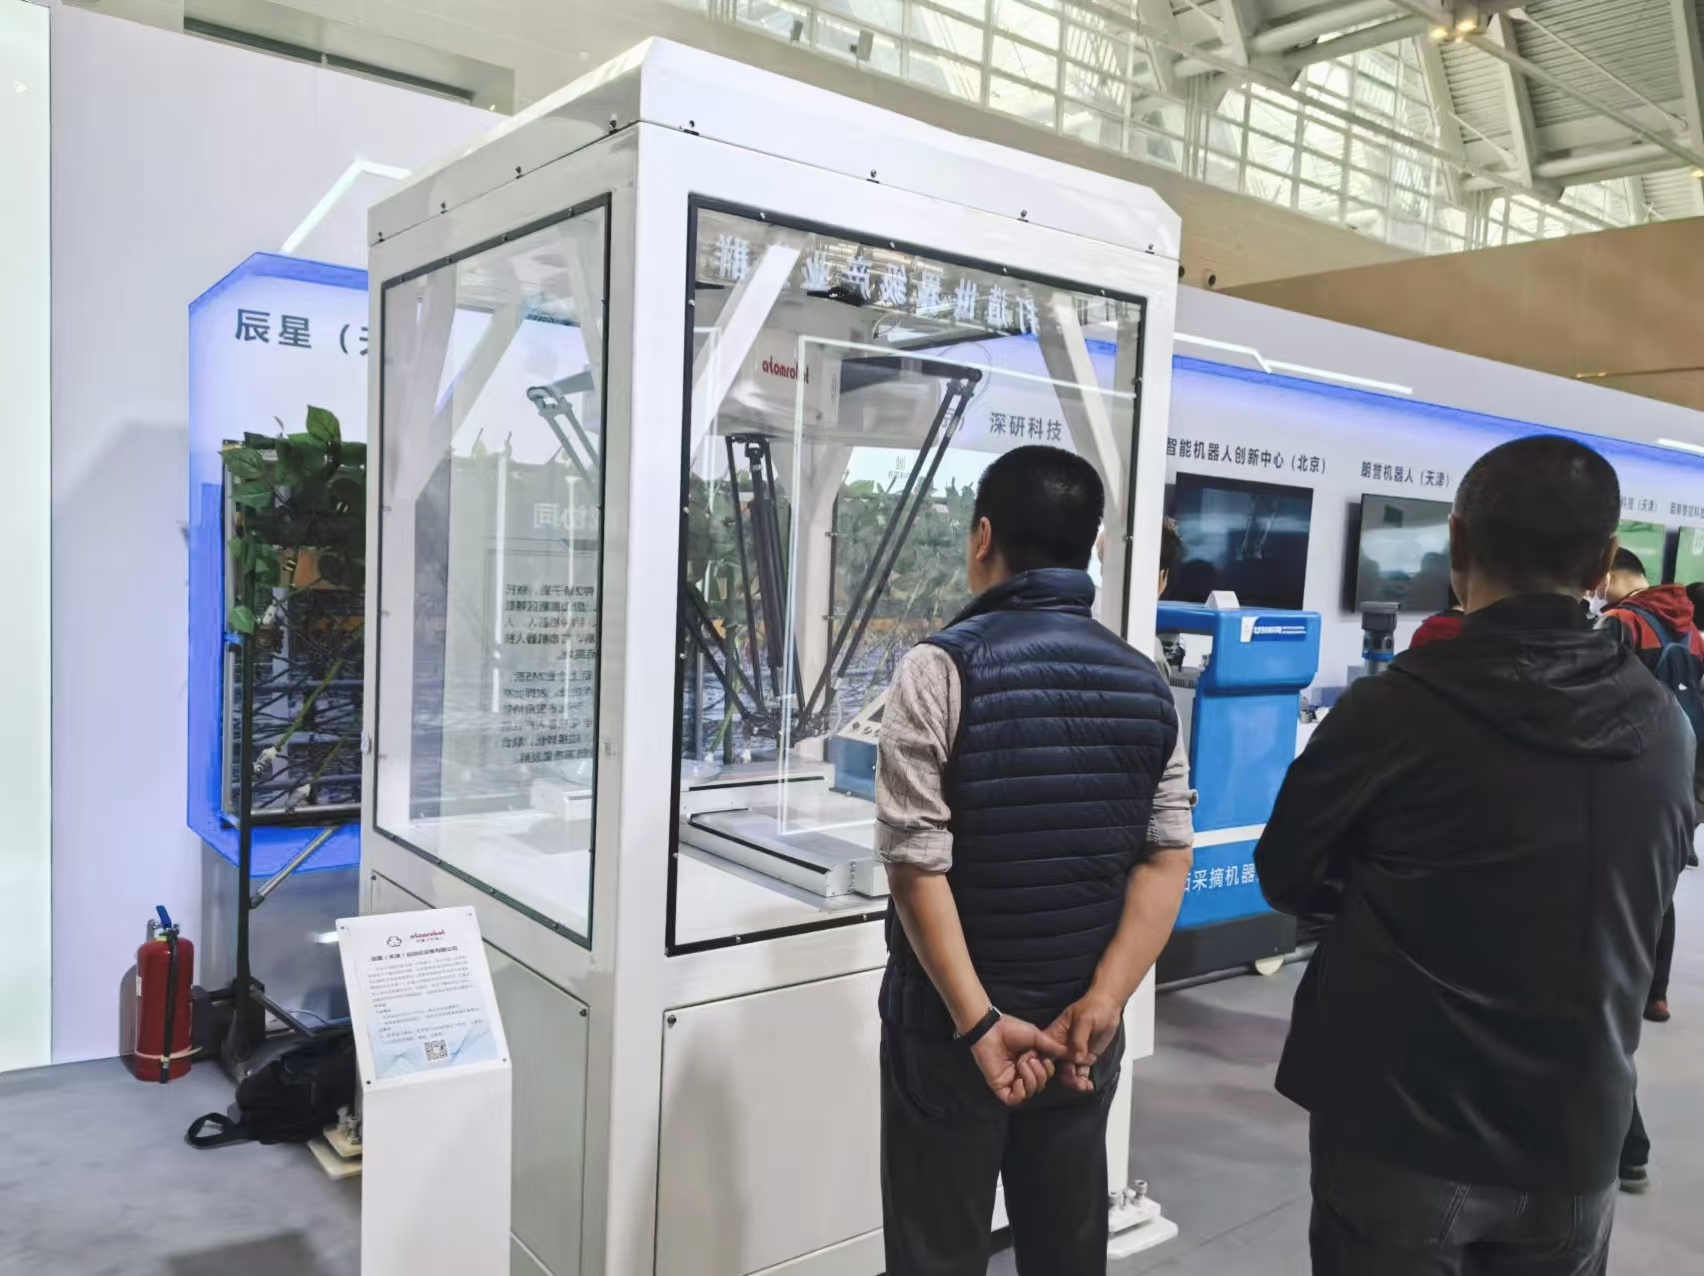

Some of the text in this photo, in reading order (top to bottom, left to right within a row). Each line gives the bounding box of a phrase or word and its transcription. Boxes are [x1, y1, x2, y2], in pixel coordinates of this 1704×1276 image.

[762, 355, 809, 384] atomrot
[989, 411, 1062, 442] 深研科技
[1184, 863, 1260, 892] 采摘机器
